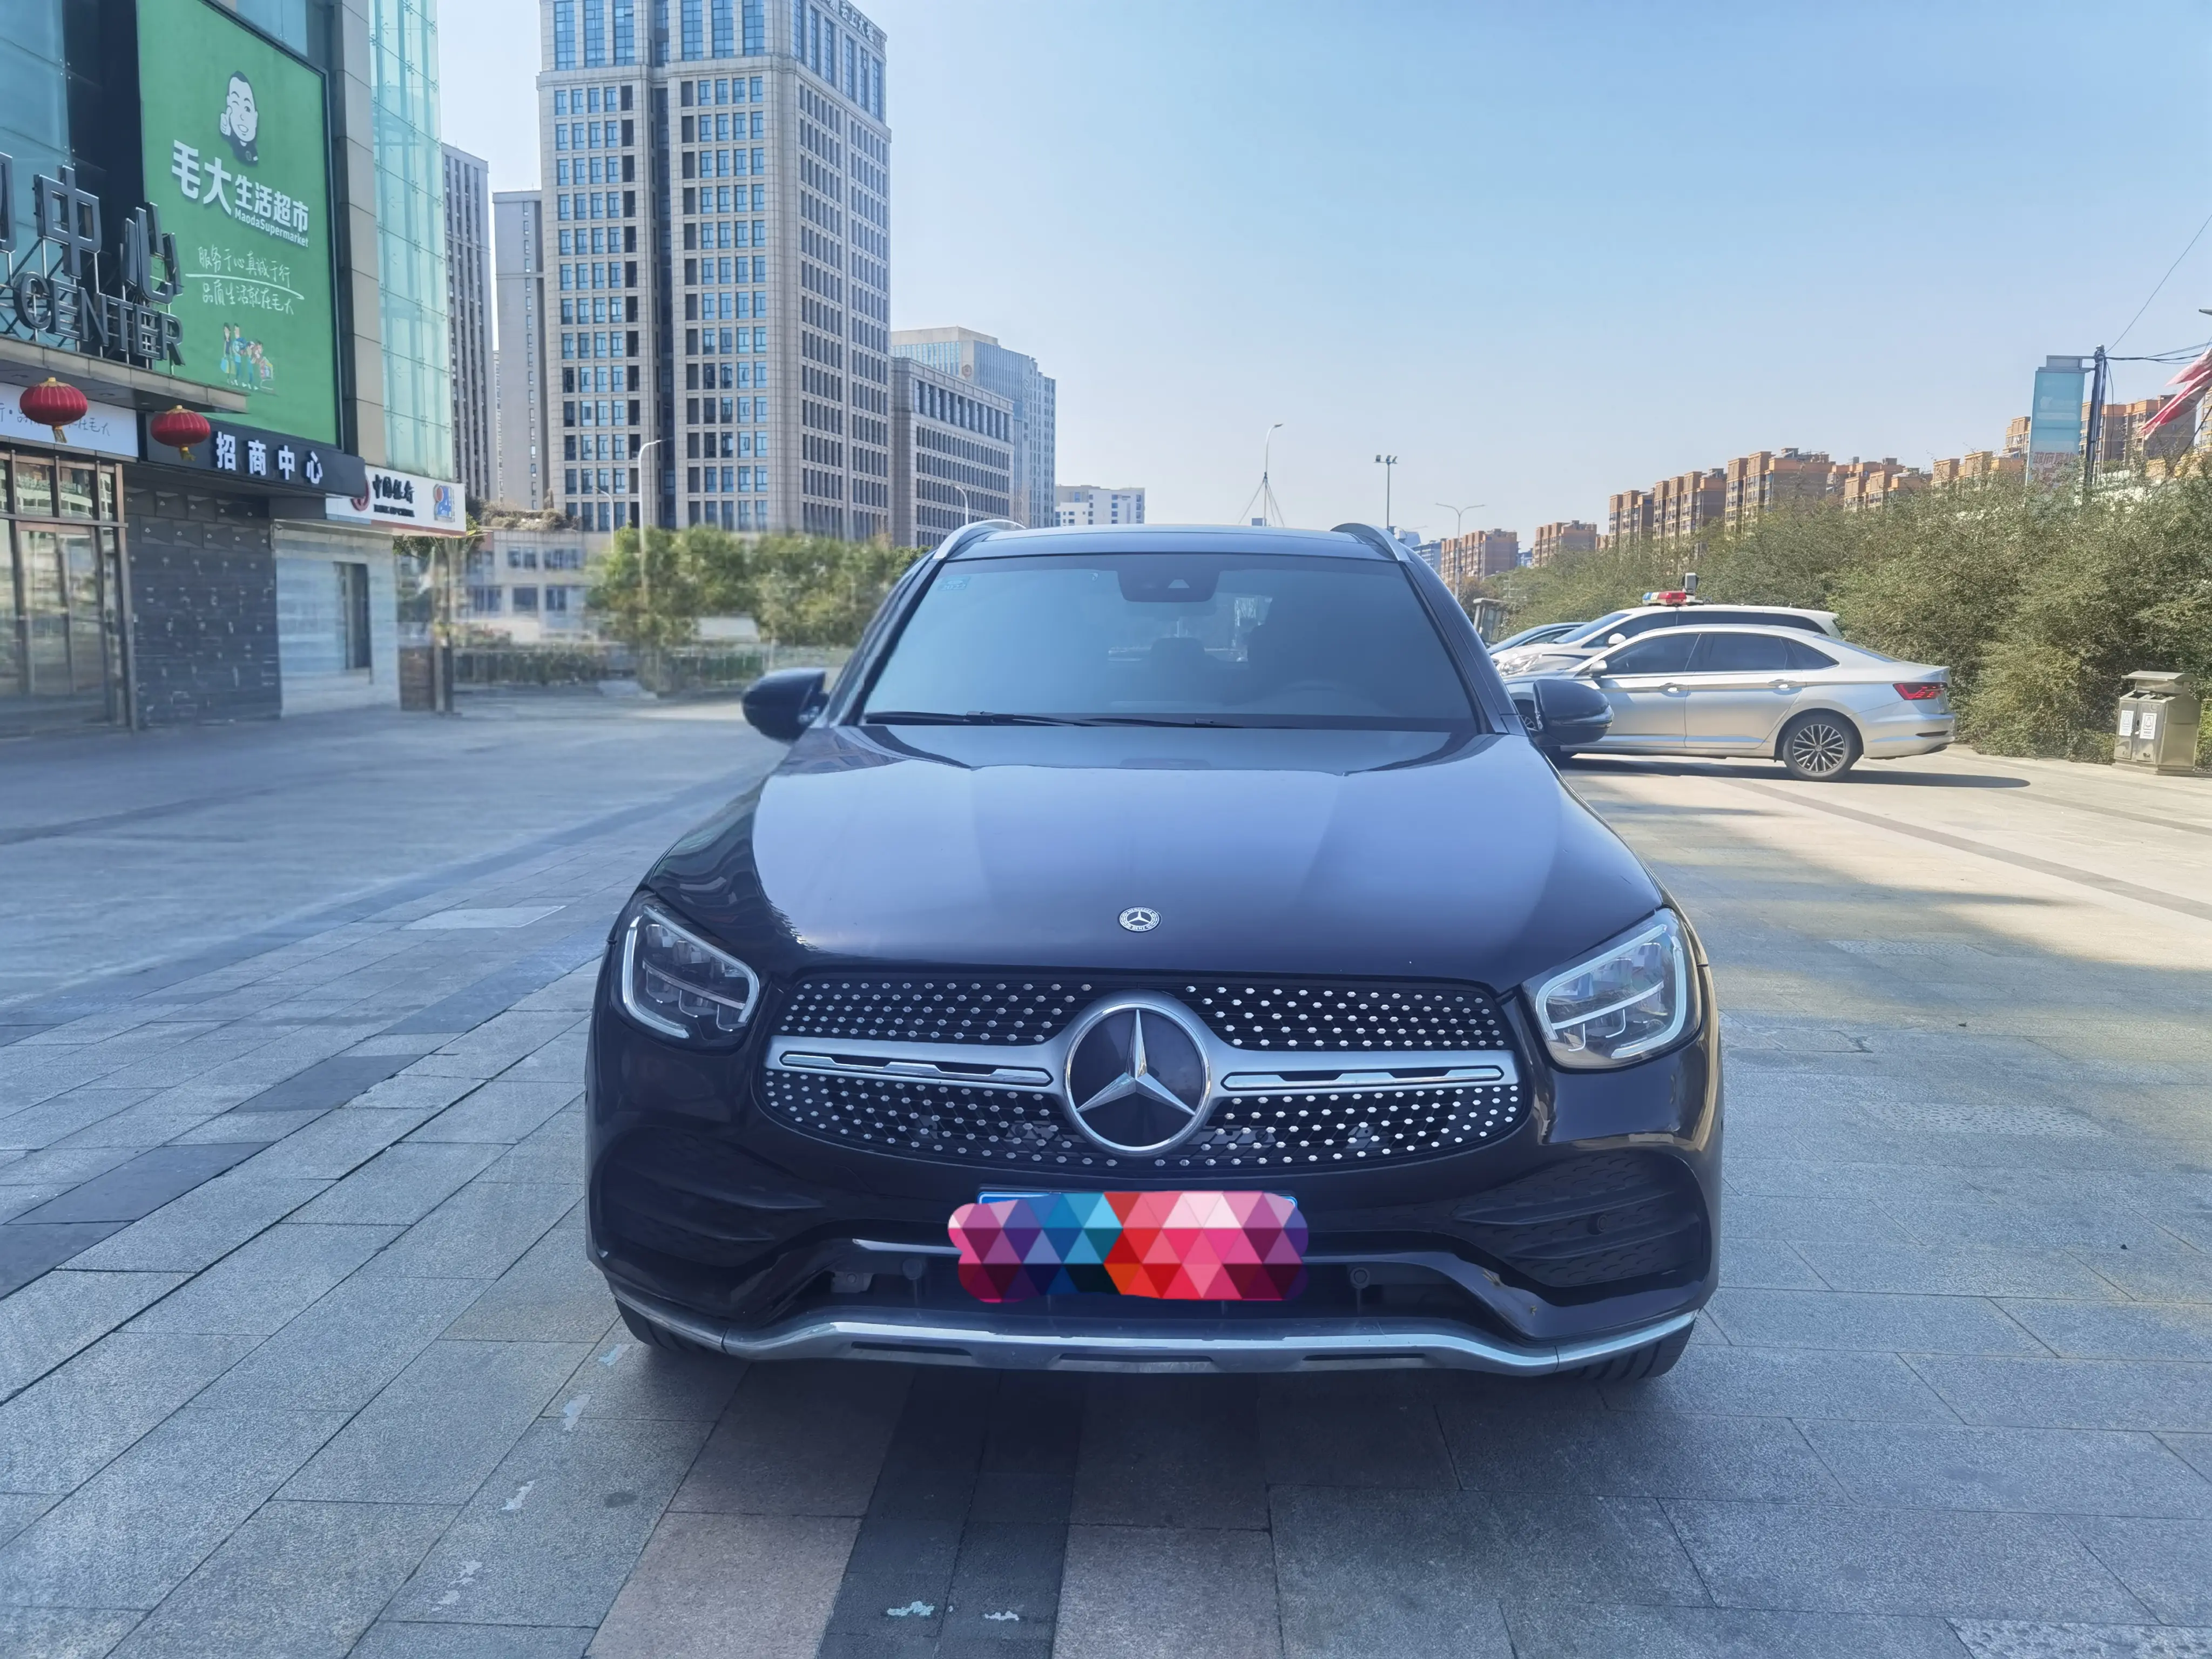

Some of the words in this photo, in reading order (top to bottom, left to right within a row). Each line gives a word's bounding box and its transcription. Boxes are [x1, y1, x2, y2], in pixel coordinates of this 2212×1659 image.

[172, 139, 309, 232] 毛大生活超市
[234, 207, 309, 247] MaodaSupermarket
[13, 272, 185, 366] CENTER
[217, 431, 323, 484] 招商中心
